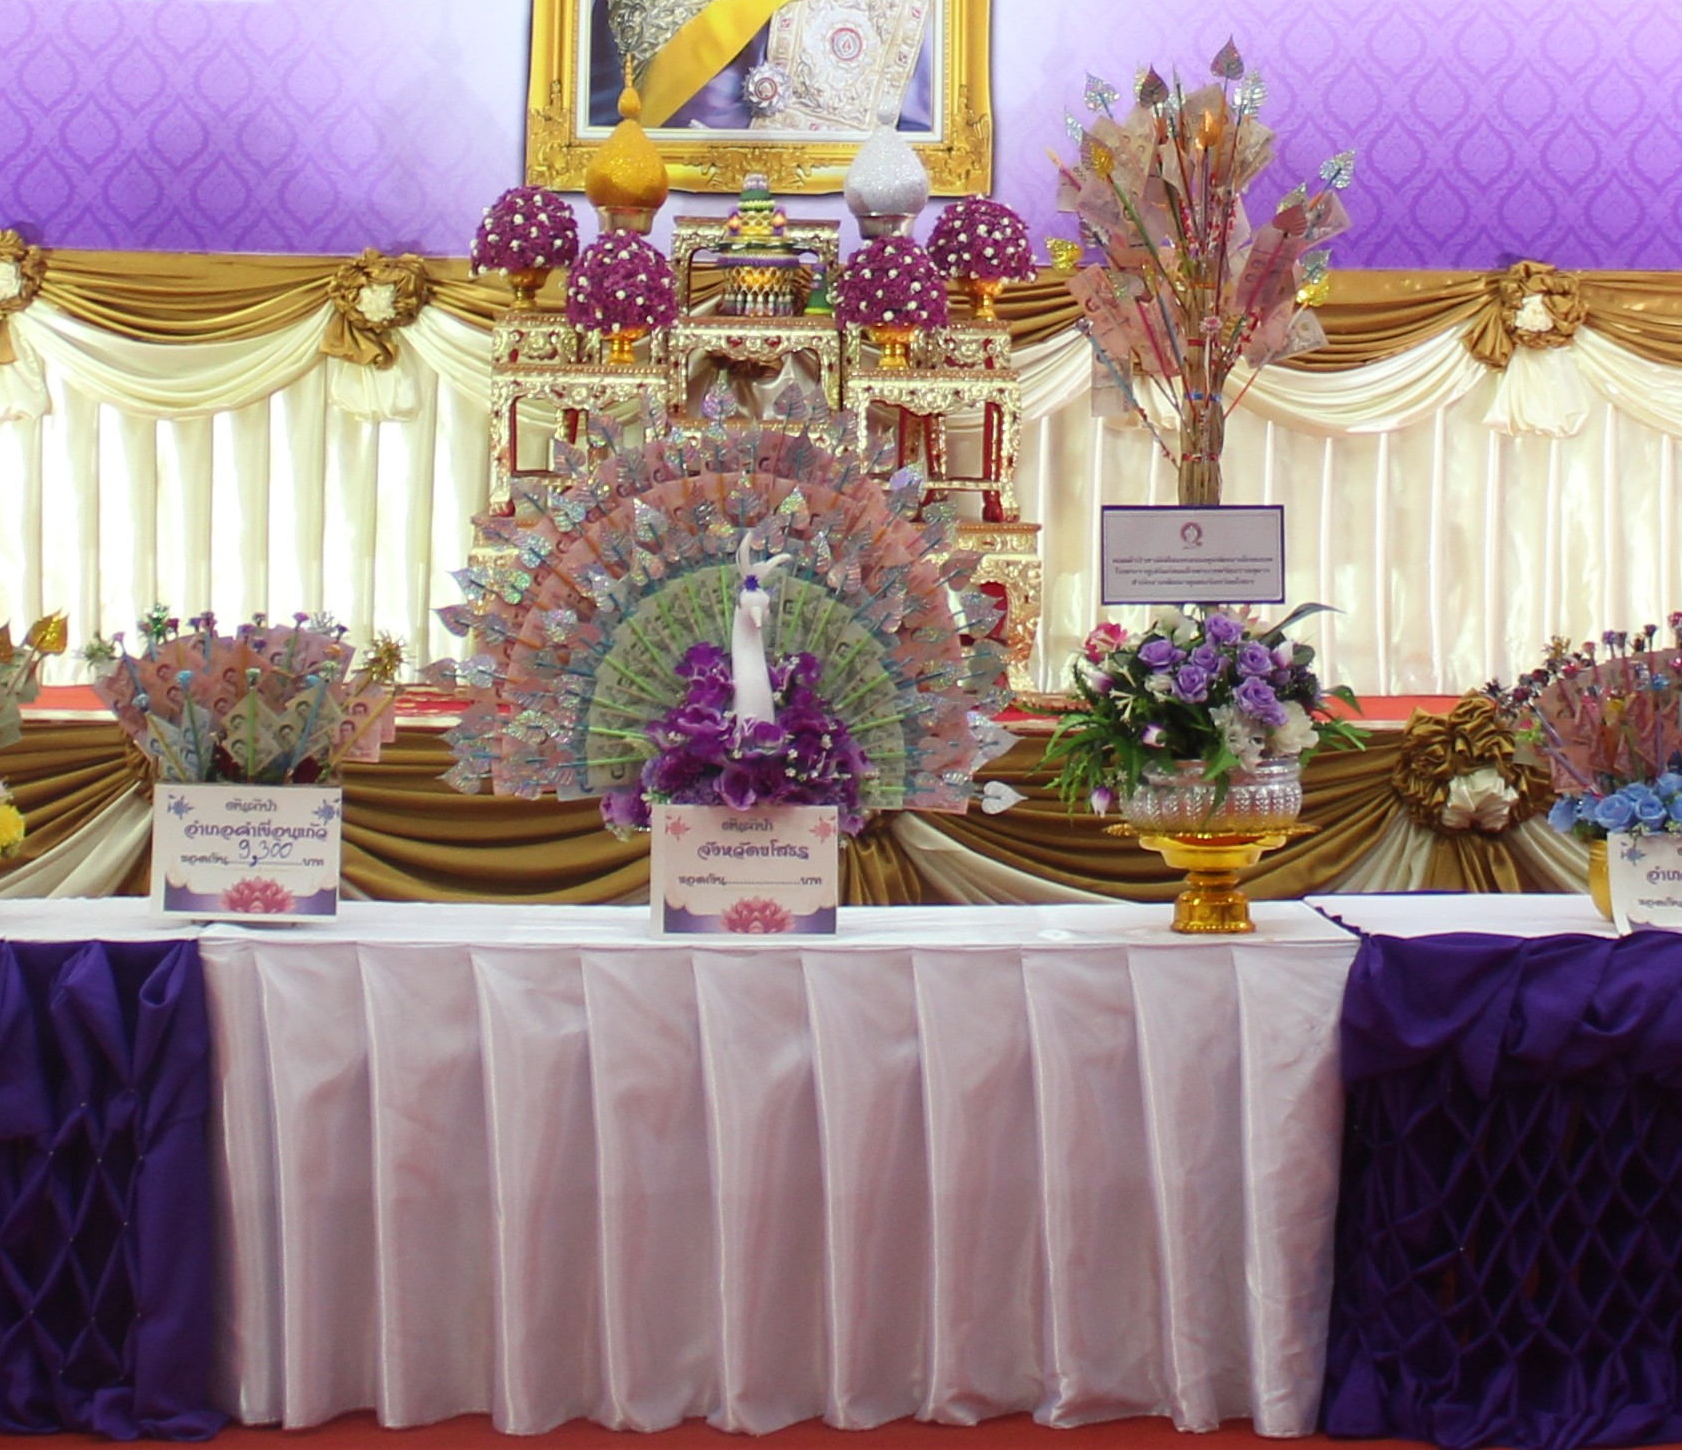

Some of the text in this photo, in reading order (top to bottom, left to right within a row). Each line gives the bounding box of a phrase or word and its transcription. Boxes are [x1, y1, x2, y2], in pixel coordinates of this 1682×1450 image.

[184, 819, 328, 841] อำเภอคำเขื่อนแก้ว
[238, 838, 293, 867] 9,300
[697, 839, 810, 861] จังหวัดยโสธร
